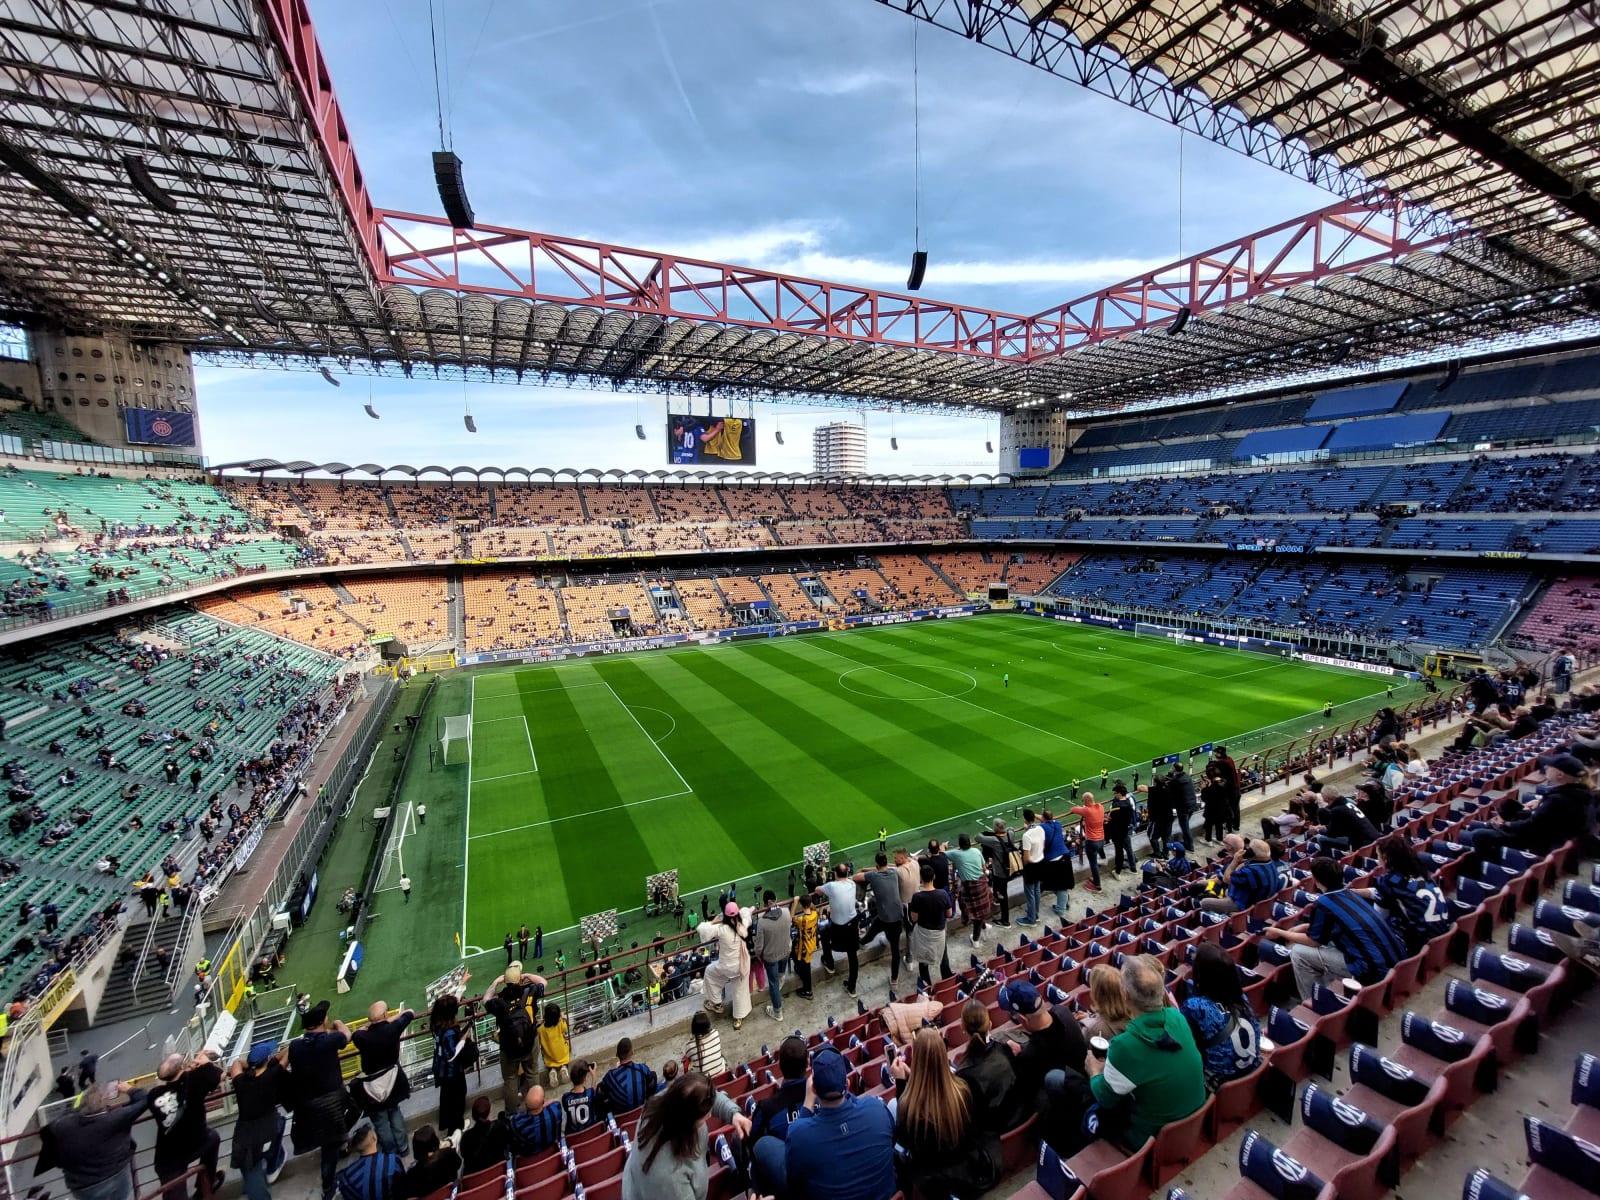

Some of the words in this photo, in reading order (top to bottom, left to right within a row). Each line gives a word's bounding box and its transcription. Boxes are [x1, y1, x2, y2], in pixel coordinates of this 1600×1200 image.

[684, 431, 695, 449] 10
[1507, 688, 1519, 696] 20
[1345, 802, 1366, 819] 3
[567, 1103, 590, 1125] 10
